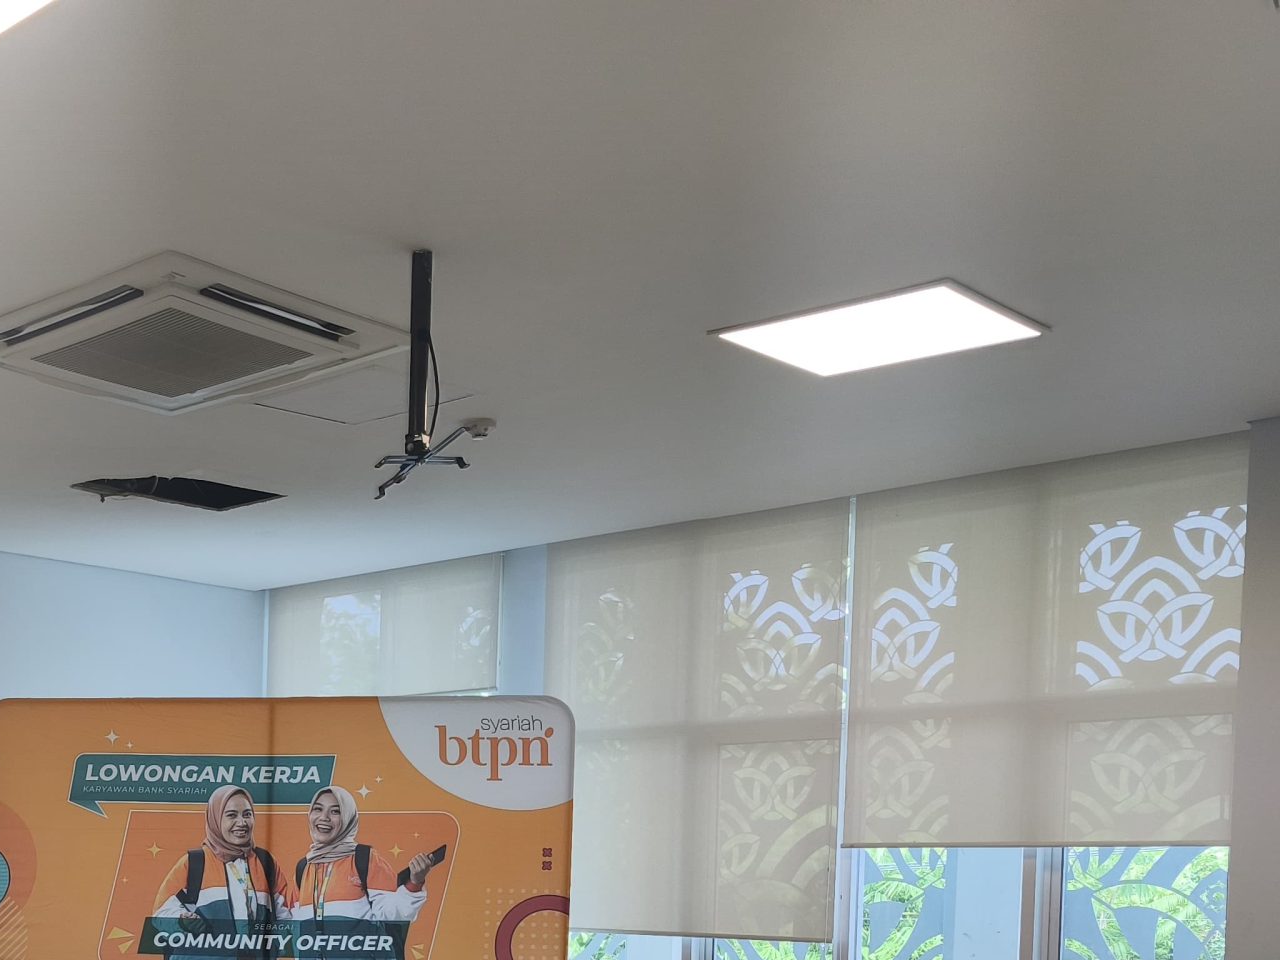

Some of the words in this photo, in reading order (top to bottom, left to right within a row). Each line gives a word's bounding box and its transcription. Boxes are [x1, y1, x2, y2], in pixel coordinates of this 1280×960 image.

[480, 715, 543, 734] syariah
[434, 725, 554, 781] btpn
[85, 763, 236, 783] LOWONGAN
[241, 765, 321, 784] KERJA
[83, 785, 135, 793] KARYAWAN
[138, 786, 164, 794] BANK
[167, 787, 207, 795] SYARIAH
[254, 922, 294, 931] SEBAGAI
[153, 931, 292, 950] COMMUNITY
[296, 935, 394, 951] OFFICER
